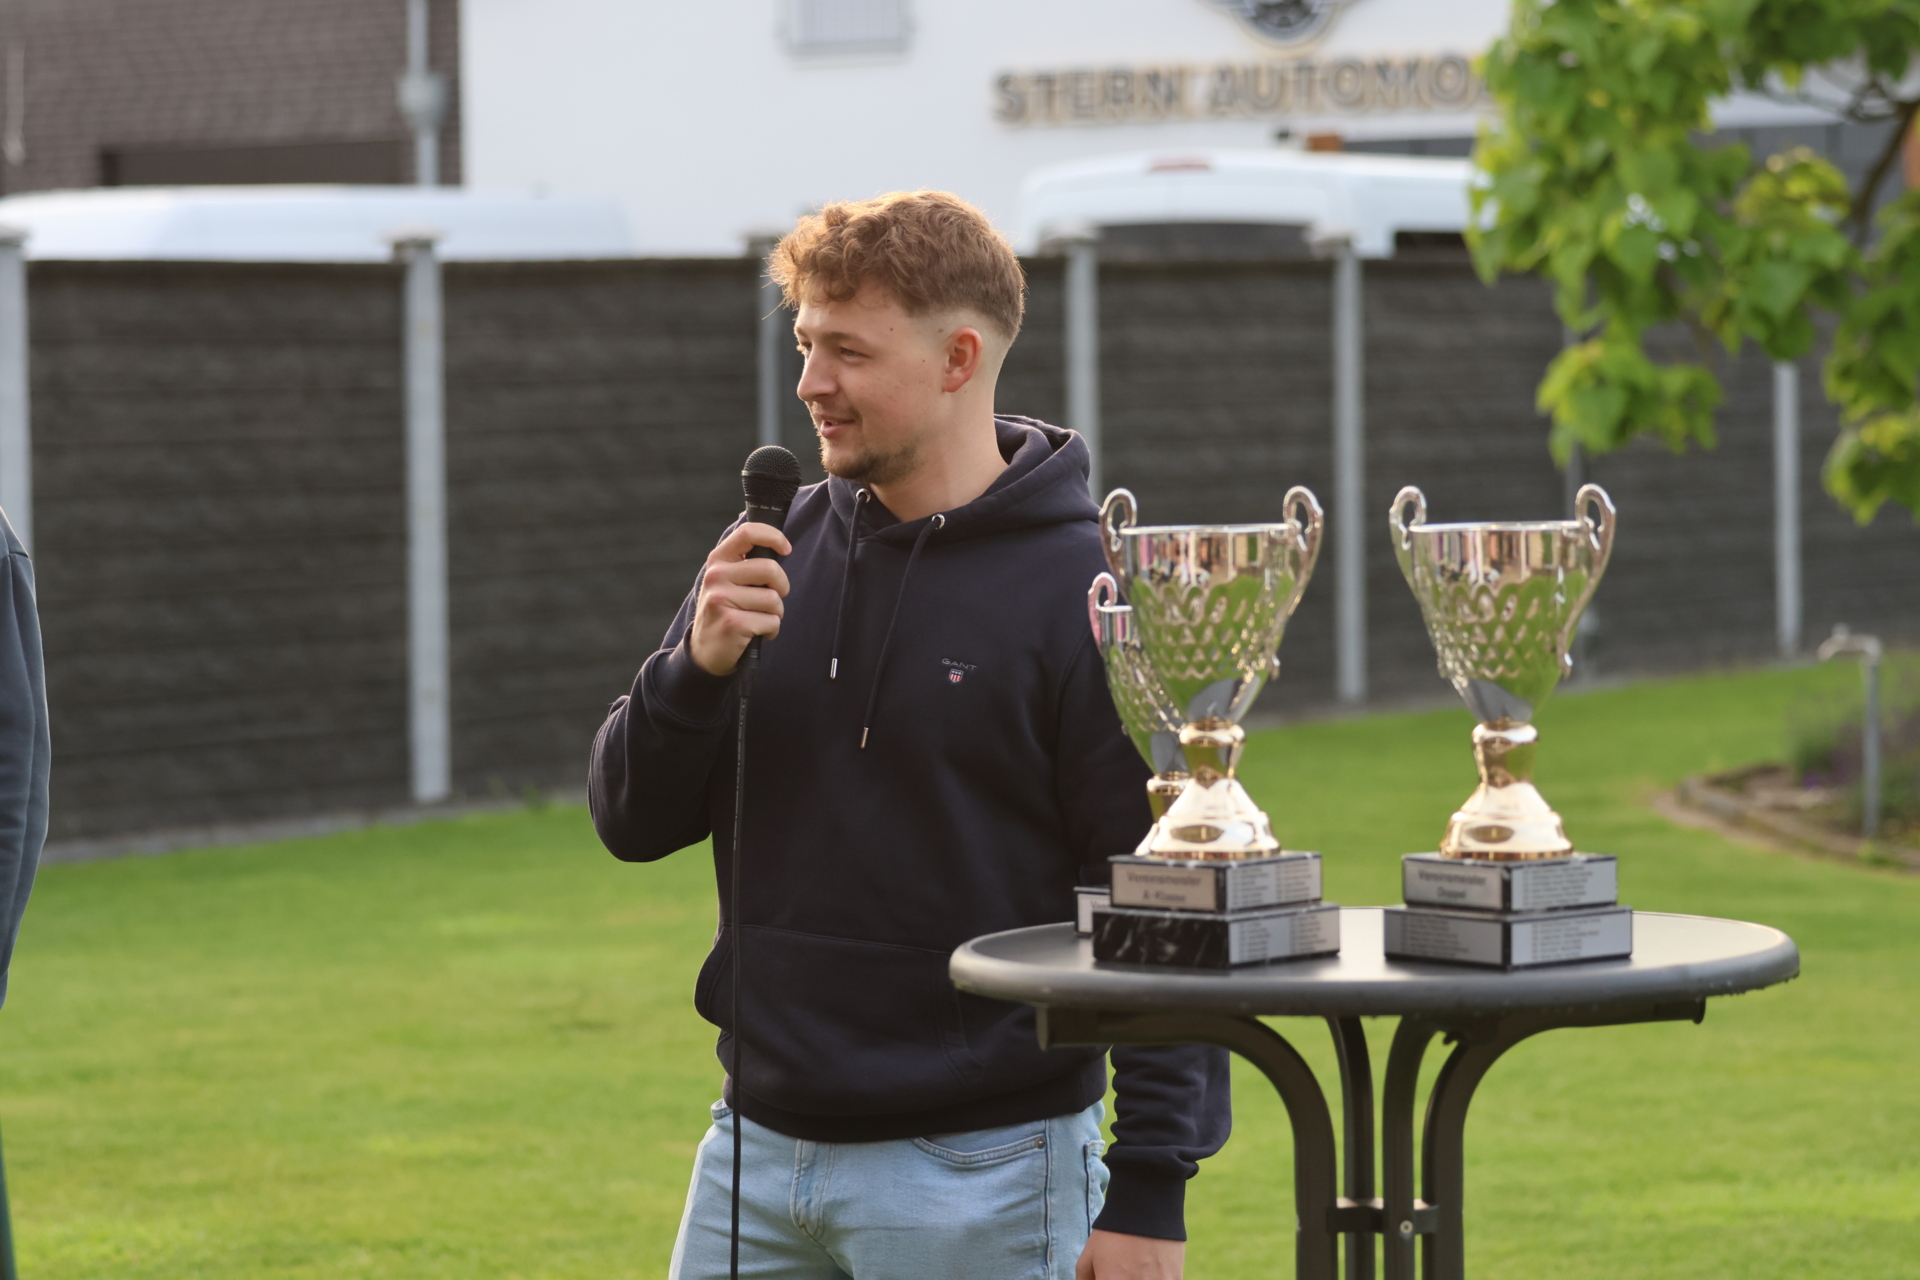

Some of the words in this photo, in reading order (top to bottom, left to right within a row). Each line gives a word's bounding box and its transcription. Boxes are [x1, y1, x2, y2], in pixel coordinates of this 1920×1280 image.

[994, 68, 1184, 127] STERN
[1206, 54, 1488, 120] AUTOMO
[941, 657, 978, 671] GANT
